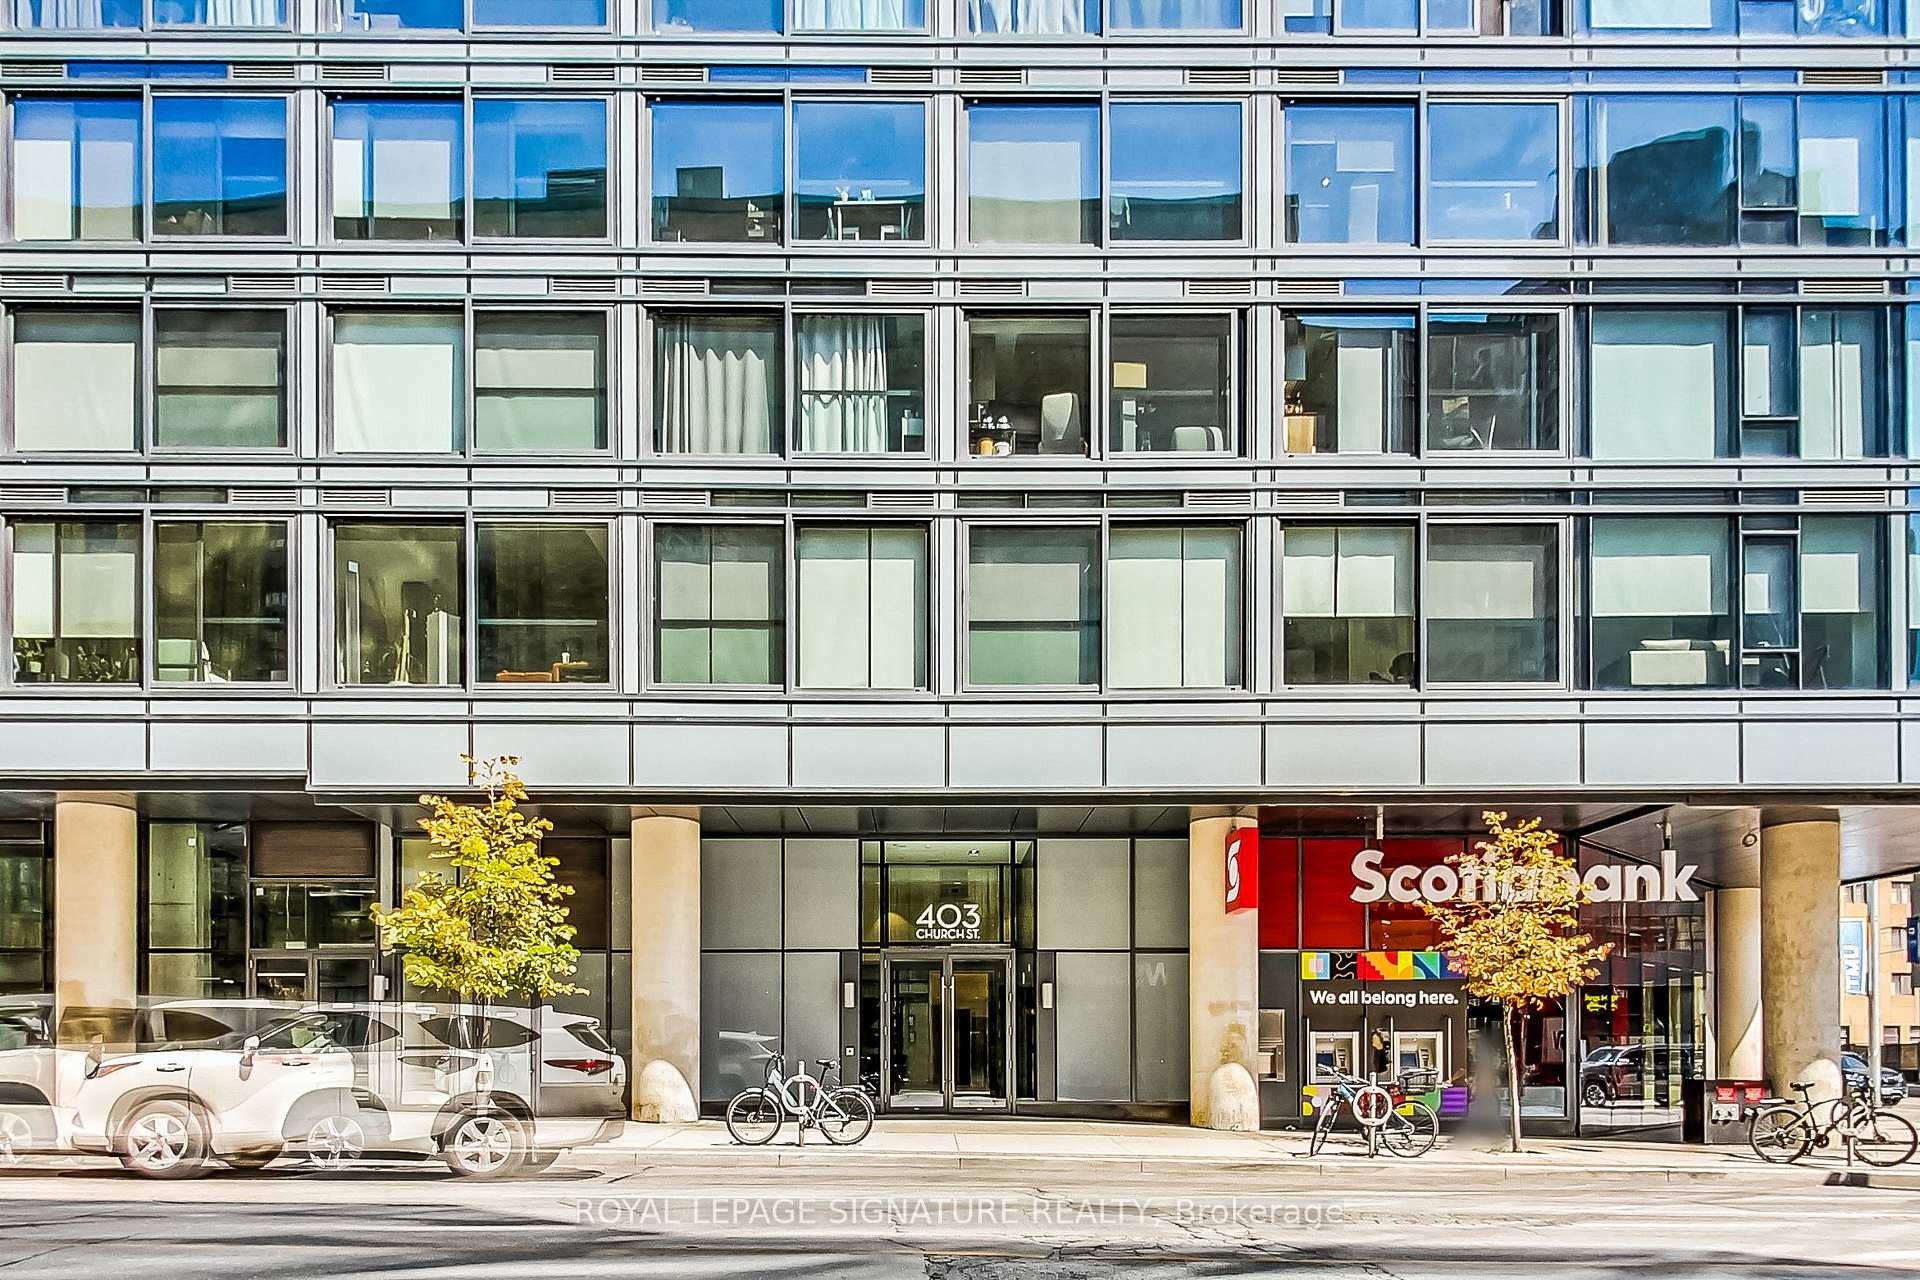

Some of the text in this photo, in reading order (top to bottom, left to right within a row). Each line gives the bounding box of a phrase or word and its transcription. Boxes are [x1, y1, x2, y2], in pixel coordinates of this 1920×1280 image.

[915, 903, 981, 928] 403
[915, 928, 981, 940] CHURCH ST.
[1309, 990, 1459, 1007] We all belong here.
